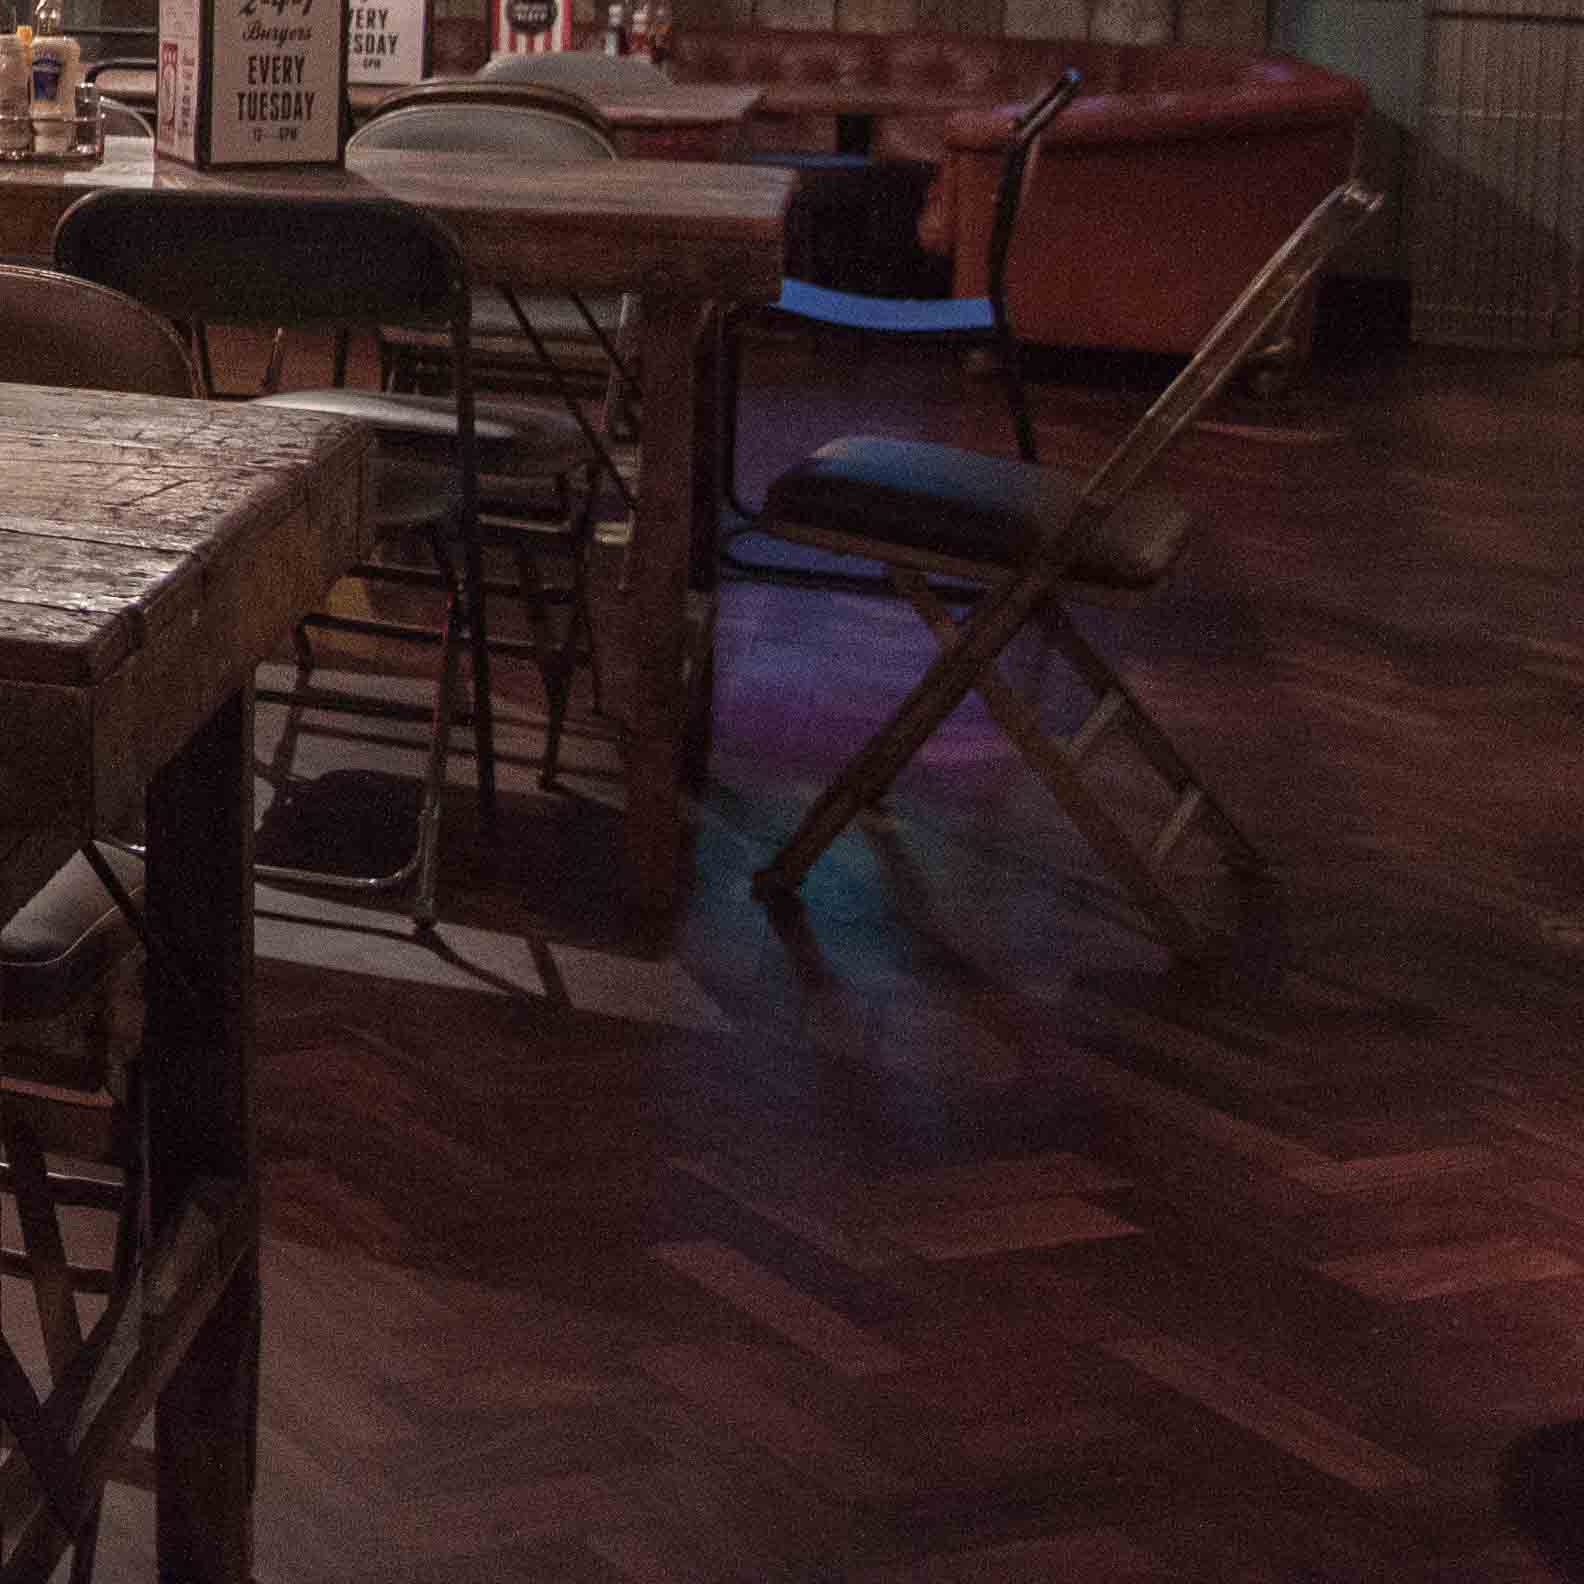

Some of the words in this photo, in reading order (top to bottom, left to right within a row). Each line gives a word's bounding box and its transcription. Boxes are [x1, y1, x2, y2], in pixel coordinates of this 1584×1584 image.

[242, 19, 313, 48] Burgers
[248, 55, 306, 85] EVERY
[237, 91, 316, 121] TUESDAY
